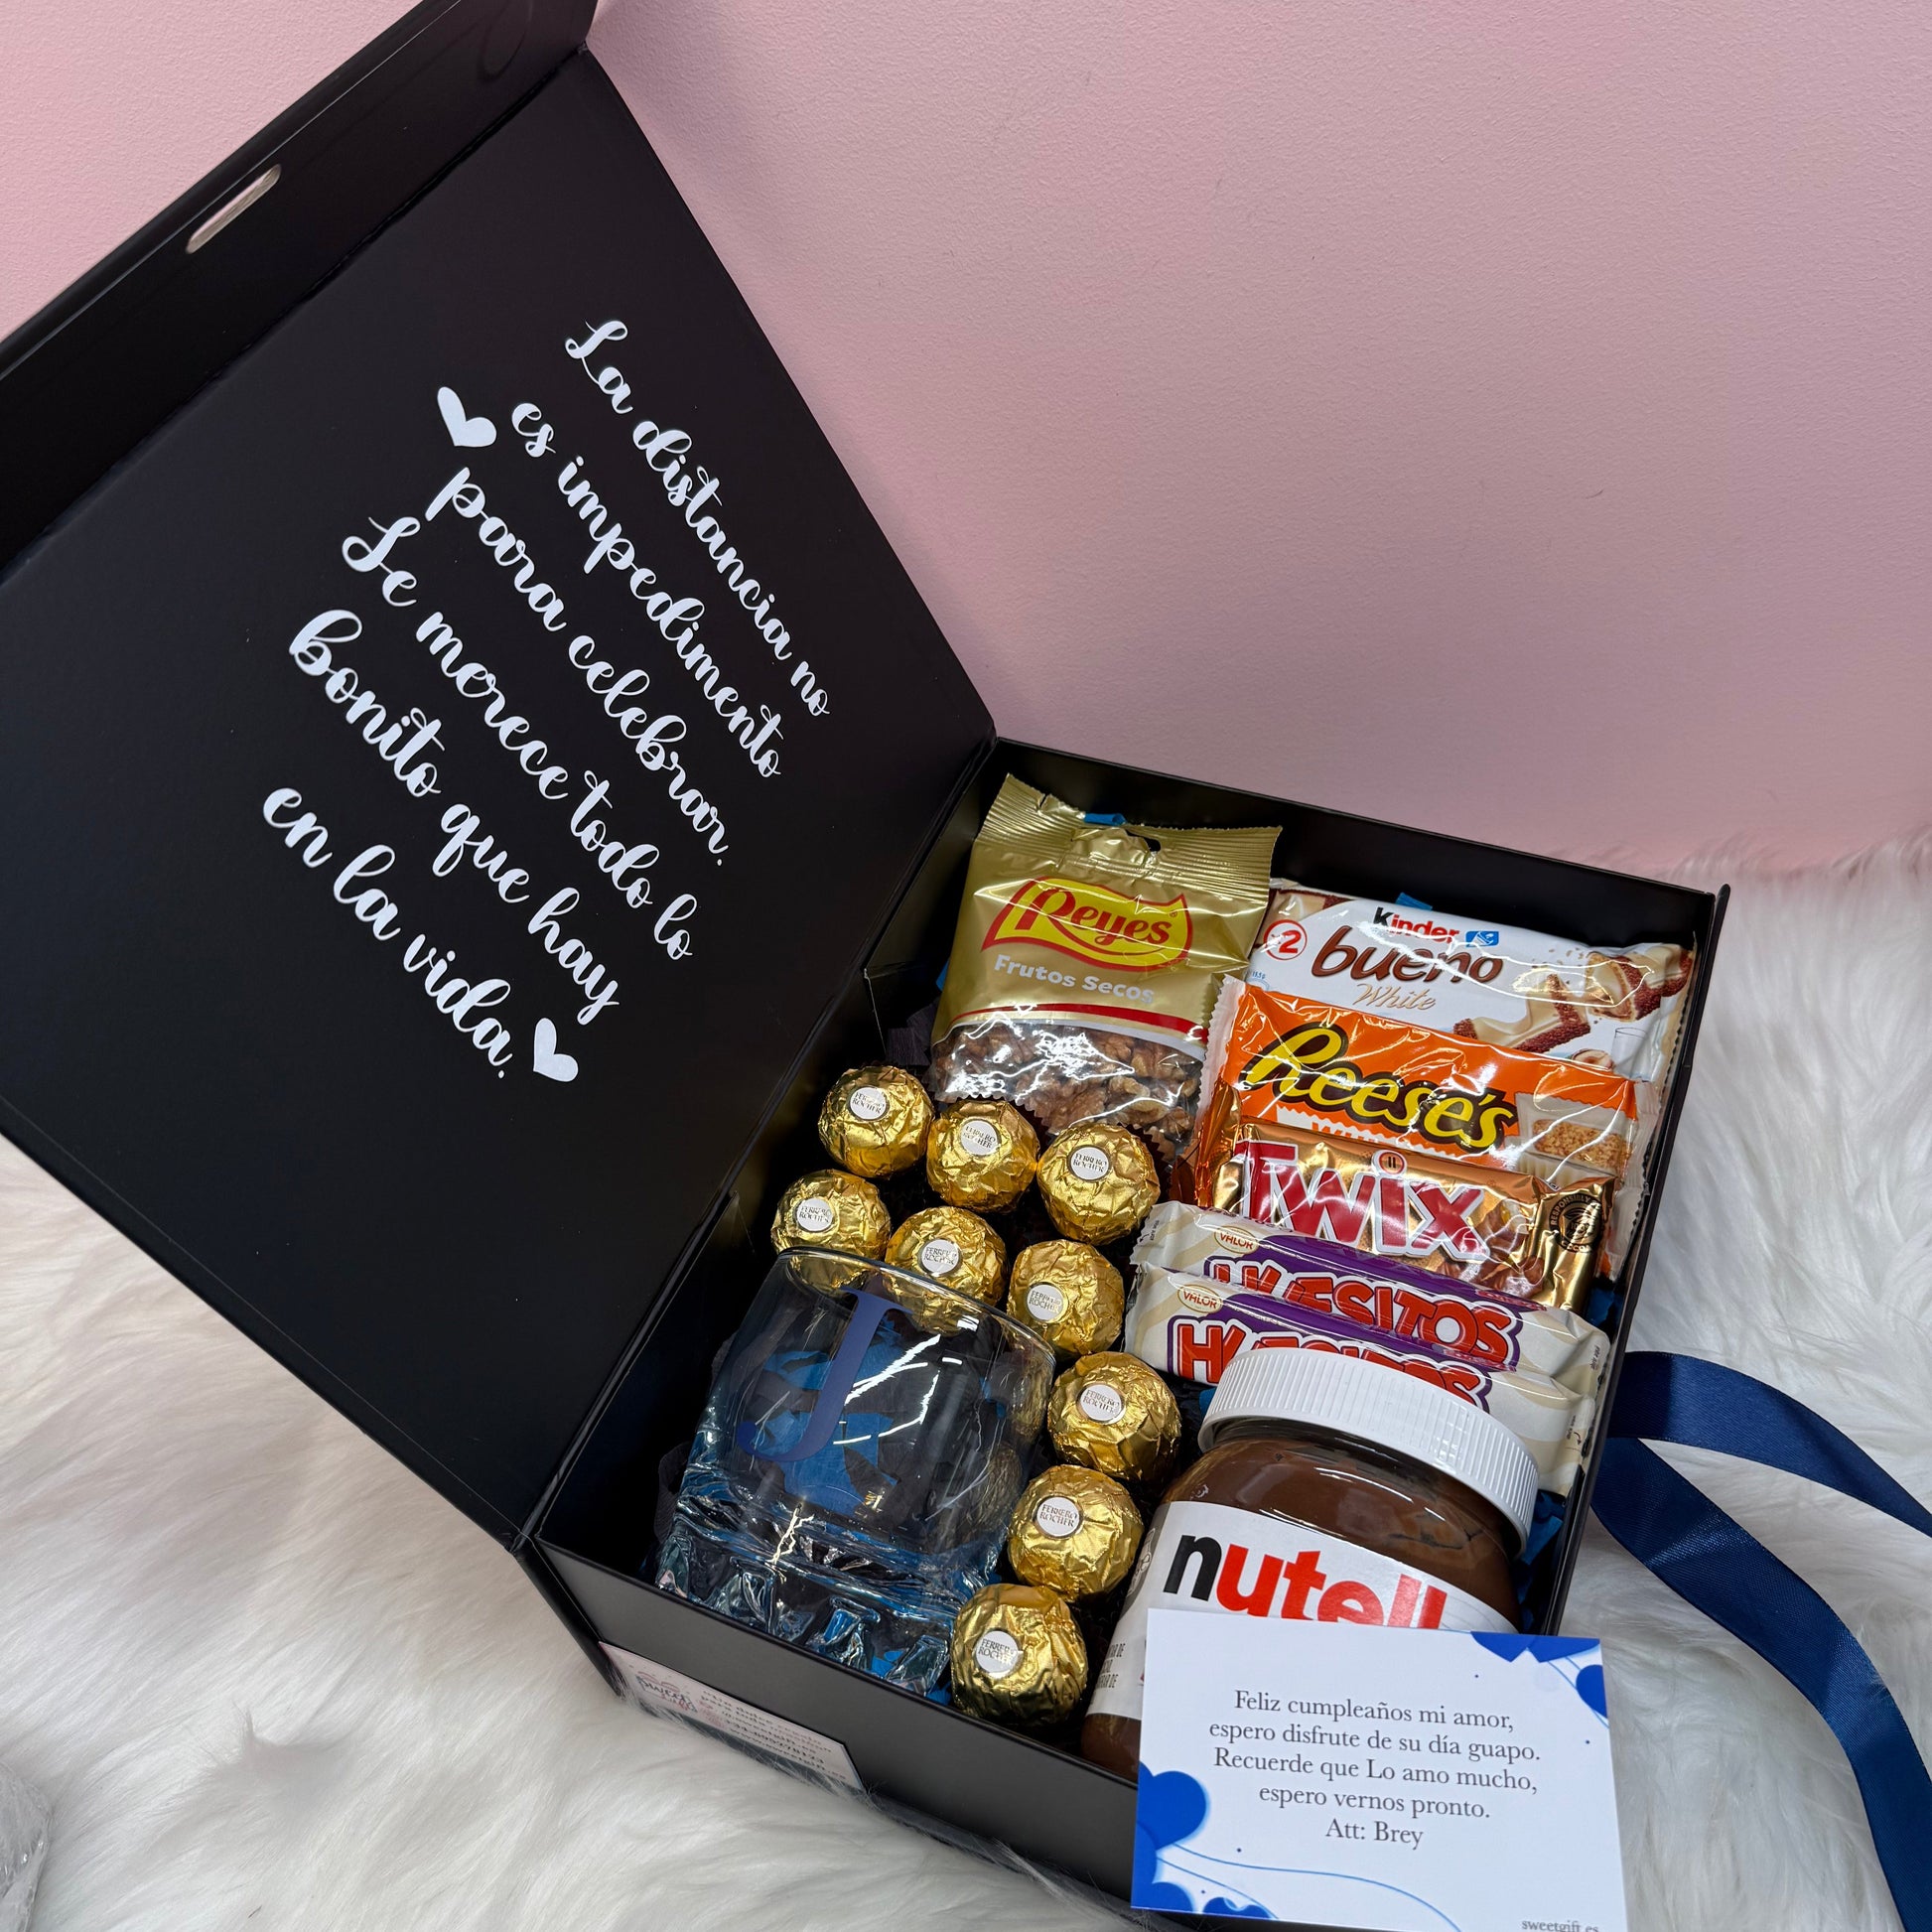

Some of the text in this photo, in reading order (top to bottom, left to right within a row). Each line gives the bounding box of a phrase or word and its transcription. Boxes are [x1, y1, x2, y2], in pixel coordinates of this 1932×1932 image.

[564, 320, 830, 717] La distancia no
[511, 402, 784, 778] es impedimento
[424, 467, 729, 867] para celebrar.
[415, 611, 569, 800] merece
[570, 769, 660, 909] todo
[653, 894, 698, 960] lo
[288, 609, 621, 1026] bonito que hay
[262, 787, 513, 1079] en la vida.
[1014, 887, 1173, 951] Reyes
[1310, 924, 1504, 984] bueno
[994, 953, 1156, 1005] Frutos Secos
[1352, 982, 1437, 1011] White
[1241, 1025, 1515, 1152] Reese's
[963, 1132, 993, 1149] ROHER
[1182, 1290, 1218, 1310] VALOR
[1086, 1389, 1120, 1407] FERRERO
[1039, 1510, 1075, 1527] ROCHER
[1041, 1503, 1077, 1520] FERRERO
[1163, 1534, 1449, 1630] nutell
[1234, 1689, 1514, 1733] Feliz cumpleaños mi amor,
[1209, 1723, 1541, 1765] espero disfrute de su día guapo.
[1213, 1746, 1538, 1795] Recuerde que Lo amo mucho,
[1259, 1786, 1491, 1819] espero vernos pronto.
[1325, 1818, 1424, 1851] Att: Brey
[1521, 1918, 1600, 1932] sweetgiftes
